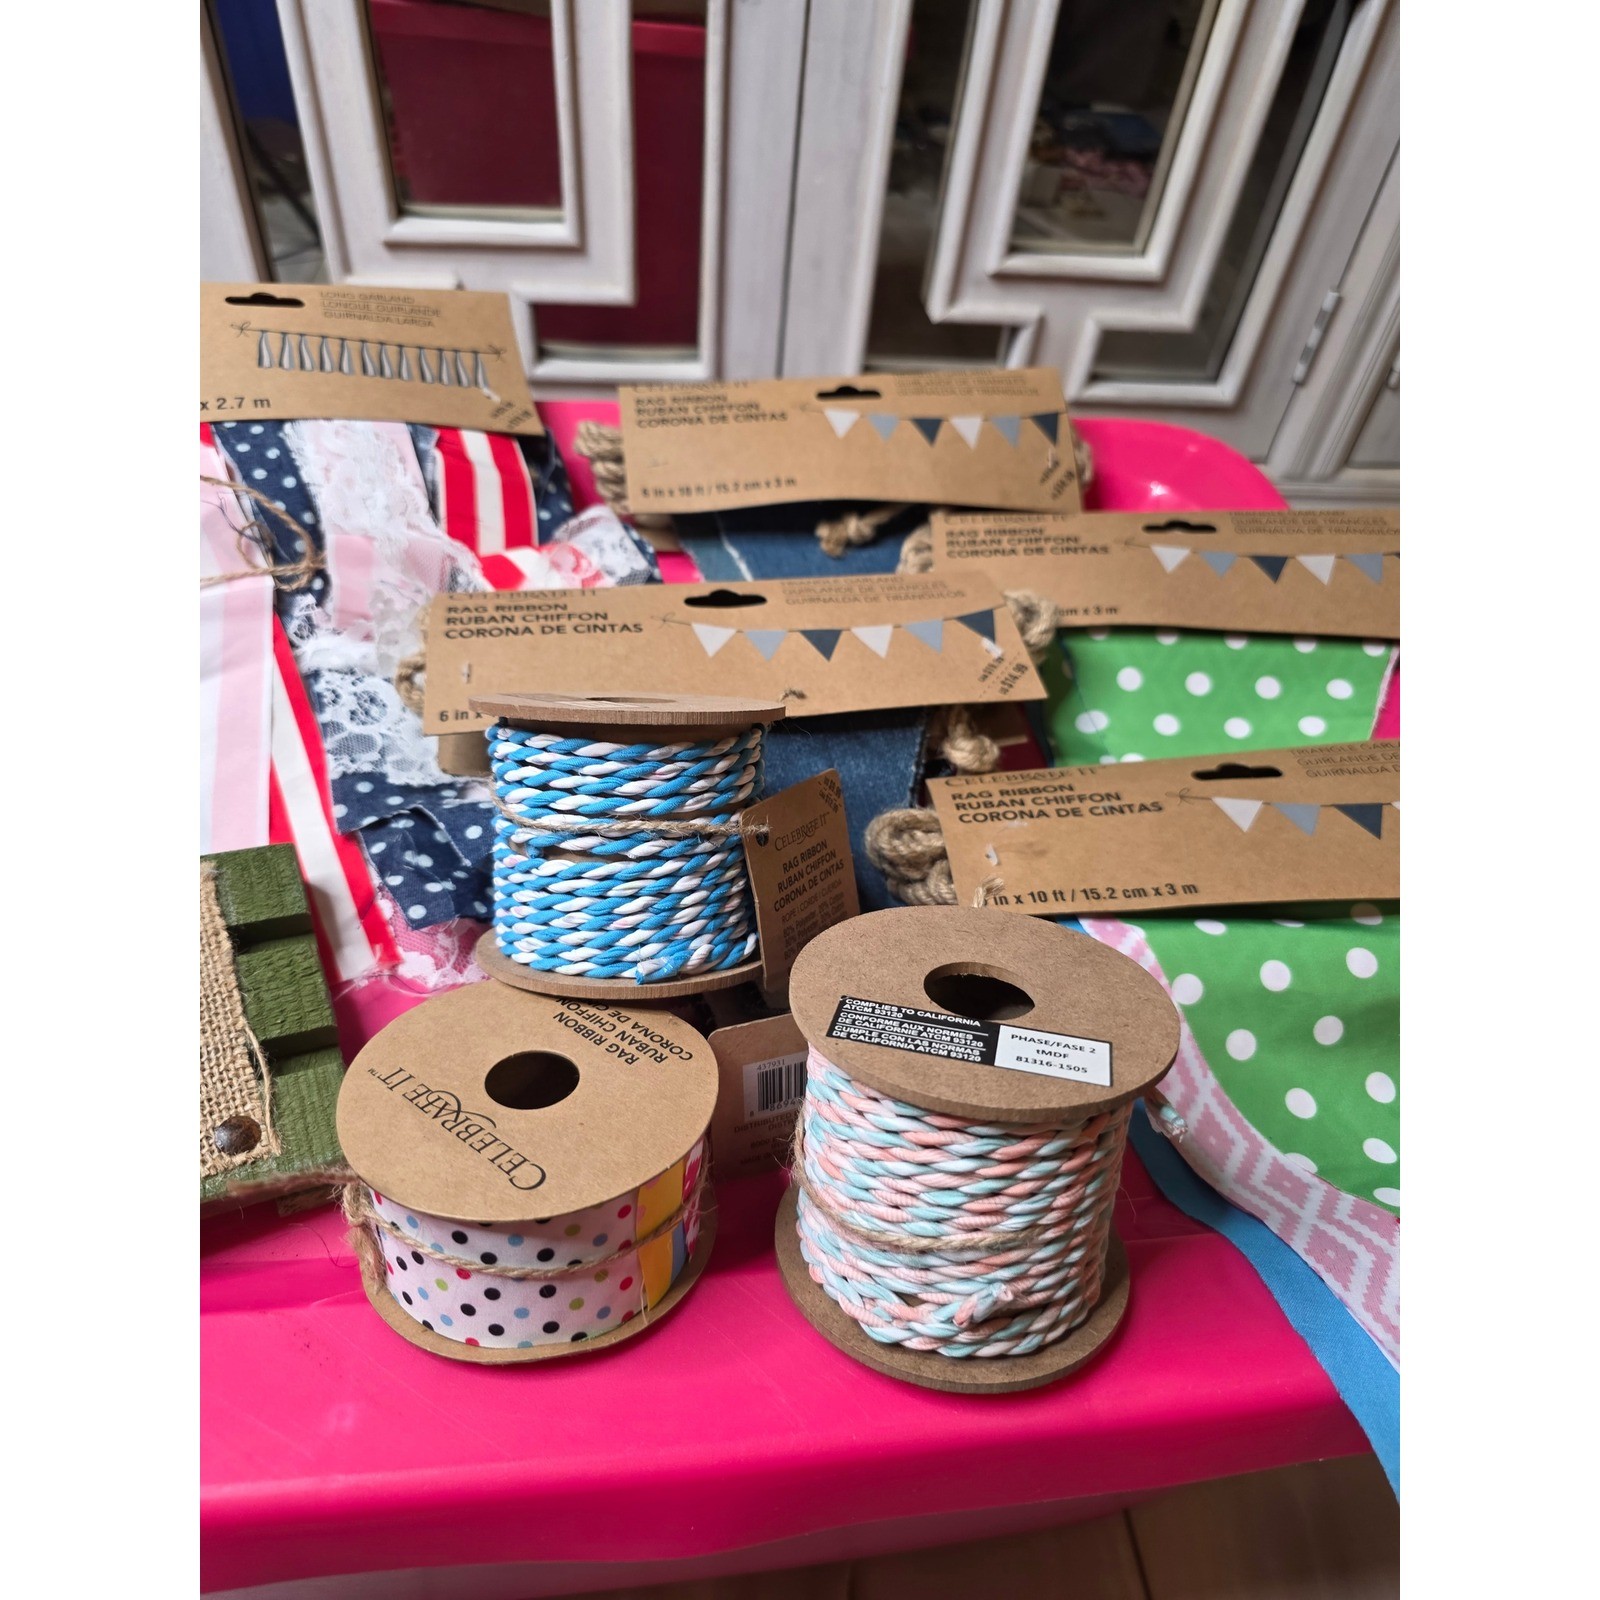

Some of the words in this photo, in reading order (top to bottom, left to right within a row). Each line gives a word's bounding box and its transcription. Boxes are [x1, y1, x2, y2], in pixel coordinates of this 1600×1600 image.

[216, 397, 246, 410] 2.7
[253, 398, 271, 408] m
[446, 614, 515, 626] RUBAN
[522, 612, 608, 623] CHIFFON
[447, 606, 487, 614] RAG
[495, 603, 568, 613] RIBBON
[445, 625, 534, 639] CORONA
[541, 624, 567, 635] DE
[573, 623, 643, 634] CINTAS
[439, 710, 449, 722] 6
[455, 709, 469, 720] in
[1306, 765, 1391, 777] GUIRNALDA
[951, 790, 993, 800] RAG
[998, 784, 1074, 797] RIBBON
[954, 799, 1025, 811] RUBAN
[1031, 792, 1121, 806] CHIFFON
[958, 809, 1049, 823] CORONA
[1056, 807, 1083, 818] DE
[1088, 802, 1163, 816] CINTAS
[774, 816, 820, 851] CELEBRATE
[783, 856, 799, 874] RAG
[800, 839, 828, 863] RIBBON
[778, 869, 804, 894] RUBAN
[805, 849, 836, 875] CHIFFON
[774, 882, 807, 912] CORONA
[808, 875, 819, 890] DE
[820, 859, 844, 882] CINTAS
[1014, 895, 1024, 905] x
[1028, 890, 1048, 903] 10
[1052, 889, 1066, 902] ft
[1080, 887, 1117, 900] 15.2
[1122, 886, 1148, 899] cm
[1152, 886, 1163, 896] x
[1165, 883, 1176, 895] 3
[1182, 884, 1199, 894] m
[556, 998, 617, 1032] CHIFFON
[608, 1010, 632, 1024] DE
[843, 1004, 872, 1013] ATCM
[874, 1008, 903, 1018] 93120
[846, 998, 898, 1012] COMPLIES
[917, 1011, 981, 1027] CALIFORNIA
[553, 1011, 608, 1046] RIBBON
[840, 1012, 900, 1027] CONFORME
[901, 1022, 924, 1031] AUX
[927, 1027, 973, 1040] NORMES
[855, 1019, 918, 1036] CALIFORNIE
[920, 1032, 950, 1042] ATCM
[953, 1037, 983, 1047] 93120
[615, 1030, 668, 1063] RUBAN
[631, 1021, 693, 1060] CORONA
[832, 1030, 847, 1038] DE
[850, 1034, 915, 1050] CALIFORNIA
[916, 1045, 948, 1056] ATCM
[950, 1051, 981, 1062] 93120
[835, 1025, 879, 1037] CUMPLE
[881, 1033, 905, 1042] CON
[908, 1037, 929, 1047] LAS
[932, 1040, 980, 1055] NORMAS
[1011, 1034, 1085, 1051] PHASE/FASE
[605, 1043, 639, 1065] RAG
[1016, 1056, 1088, 1073] 81316-1505
[1036, 1049, 1069, 1059] tMDF
[757, 1059, 785, 1071] 437931
[734, 1113, 791, 1133] DISTRIBUTED
[402, 1083, 547, 1191] CELEBRATE
